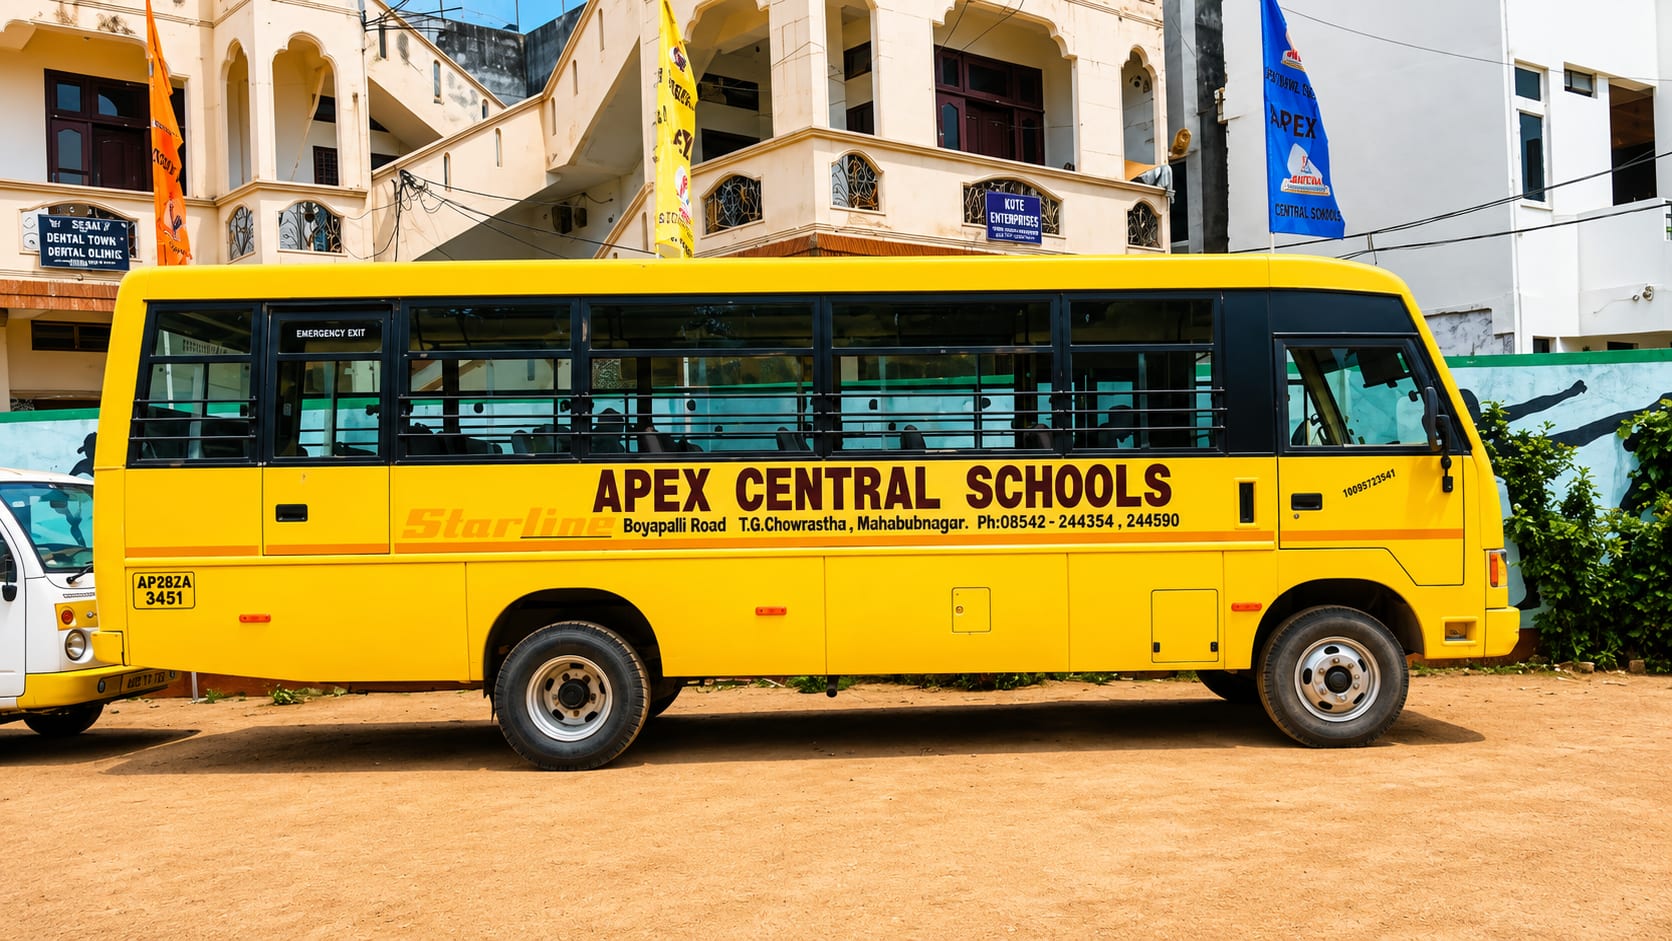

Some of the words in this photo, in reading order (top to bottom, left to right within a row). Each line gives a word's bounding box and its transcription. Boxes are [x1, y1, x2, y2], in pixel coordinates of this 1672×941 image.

[1270, 103, 1318, 139] APEX
[990, 211, 1039, 228] ENTERPRISES
[1274, 203, 1309, 218] CENTRAL
[296, 328, 346, 338] EMERGENCY
[347, 328, 366, 337] EXIT
[592, 468, 711, 513] APEX
[735, 466, 941, 512] CENTRAL
[966, 463, 1172, 510] SCHOOLS
[401, 507, 616, 539] Starline
[623, 517, 687, 538] Boyapalli
[690, 516, 726, 533] Road
[857, 515, 969, 534] Mahabubnagar.
[1126, 513, 1180, 528] 244590
[146, 590, 183, 605] 3451
